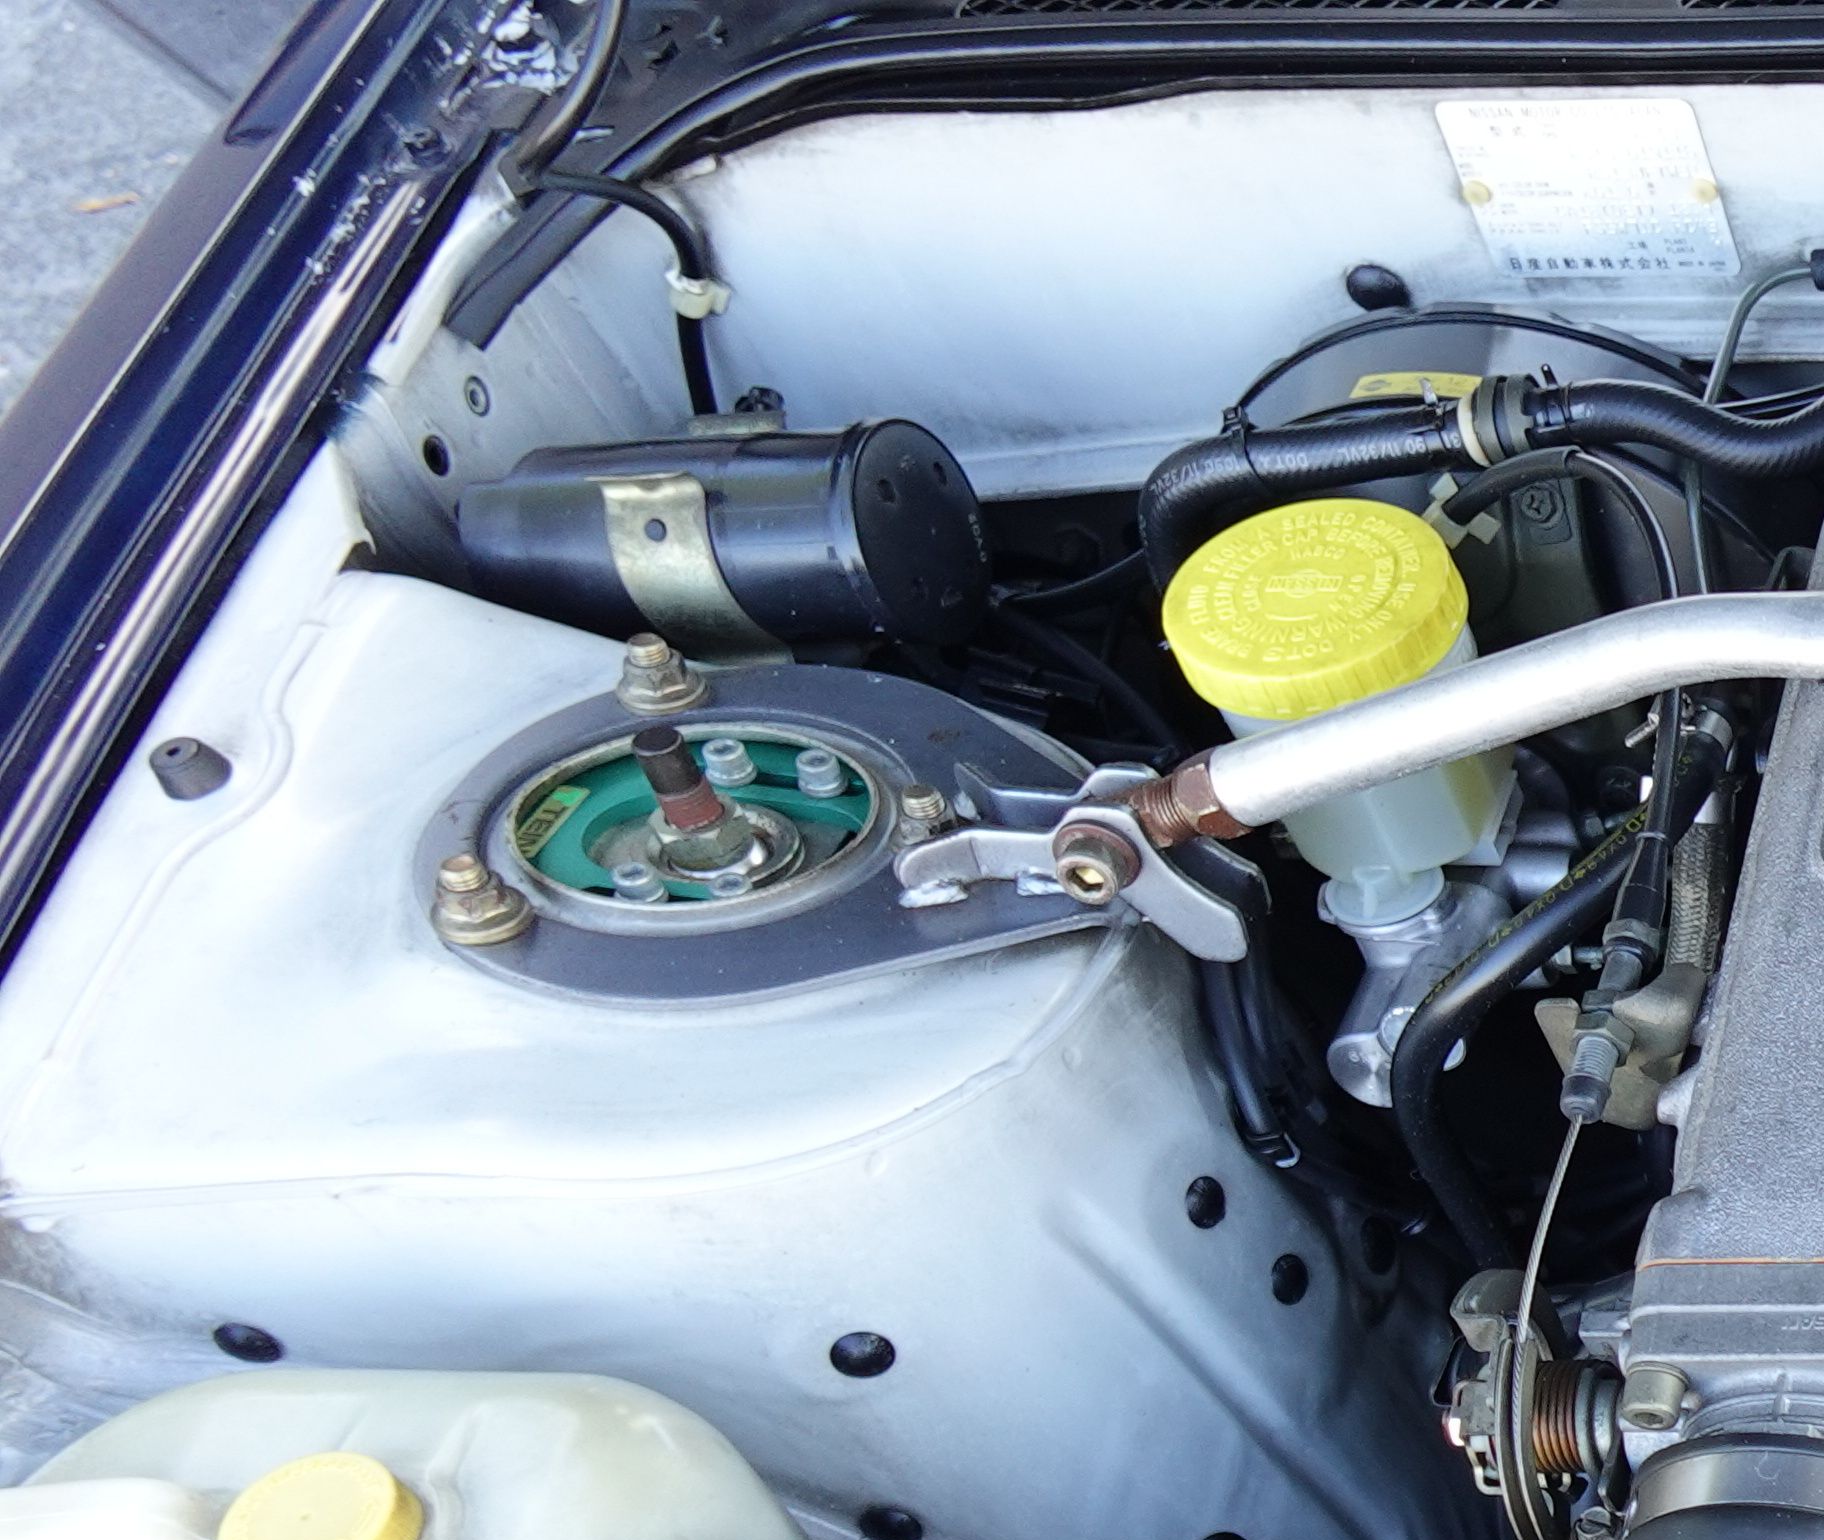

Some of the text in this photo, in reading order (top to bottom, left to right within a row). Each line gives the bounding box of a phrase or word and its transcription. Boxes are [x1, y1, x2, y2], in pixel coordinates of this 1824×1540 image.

[1508, 256, 1671, 272] 日産自動車株式会社
[1281, 511, 1356, 533] SEALED
[1281, 528, 1320, 547] CAP
